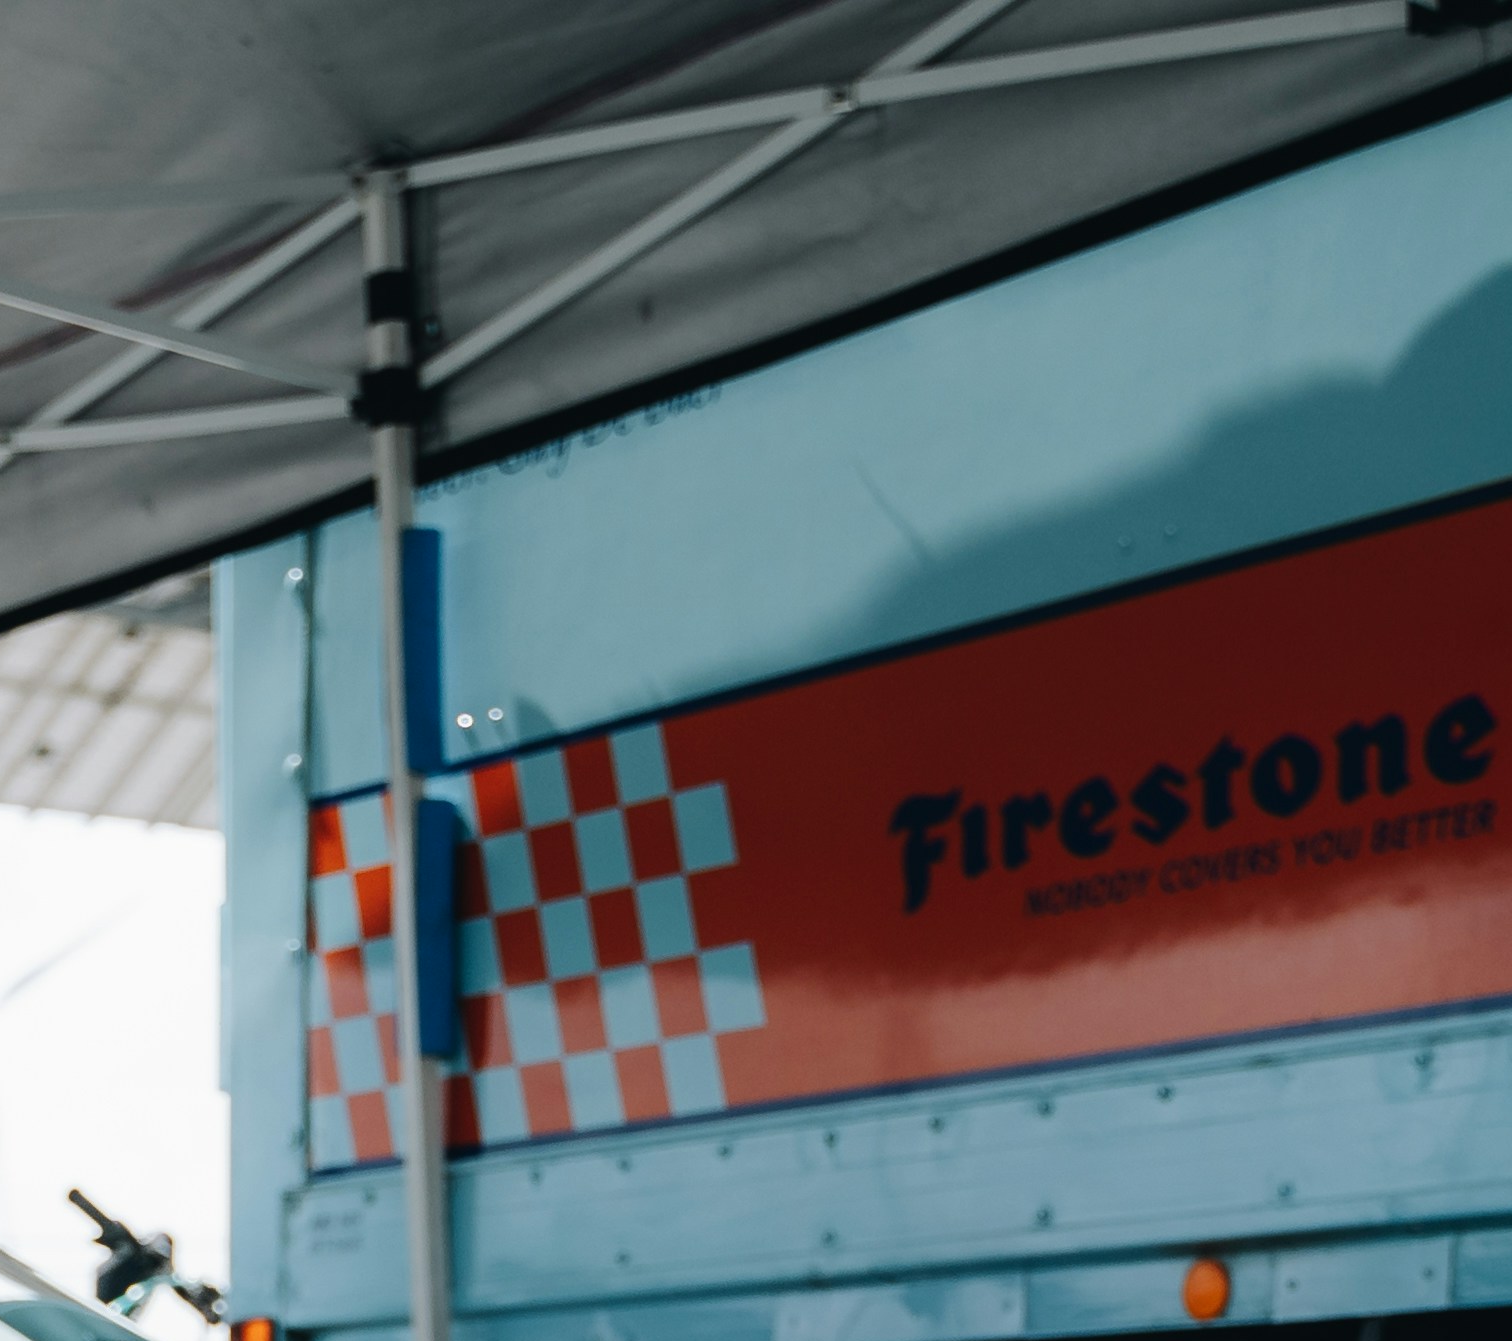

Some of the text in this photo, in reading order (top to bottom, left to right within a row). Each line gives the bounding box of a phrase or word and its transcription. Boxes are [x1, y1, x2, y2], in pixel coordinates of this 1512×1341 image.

[888, 693, 1498, 916] Firestone
[1024, 799, 1498, 917] NOBODY COVERS YOU BETTER
